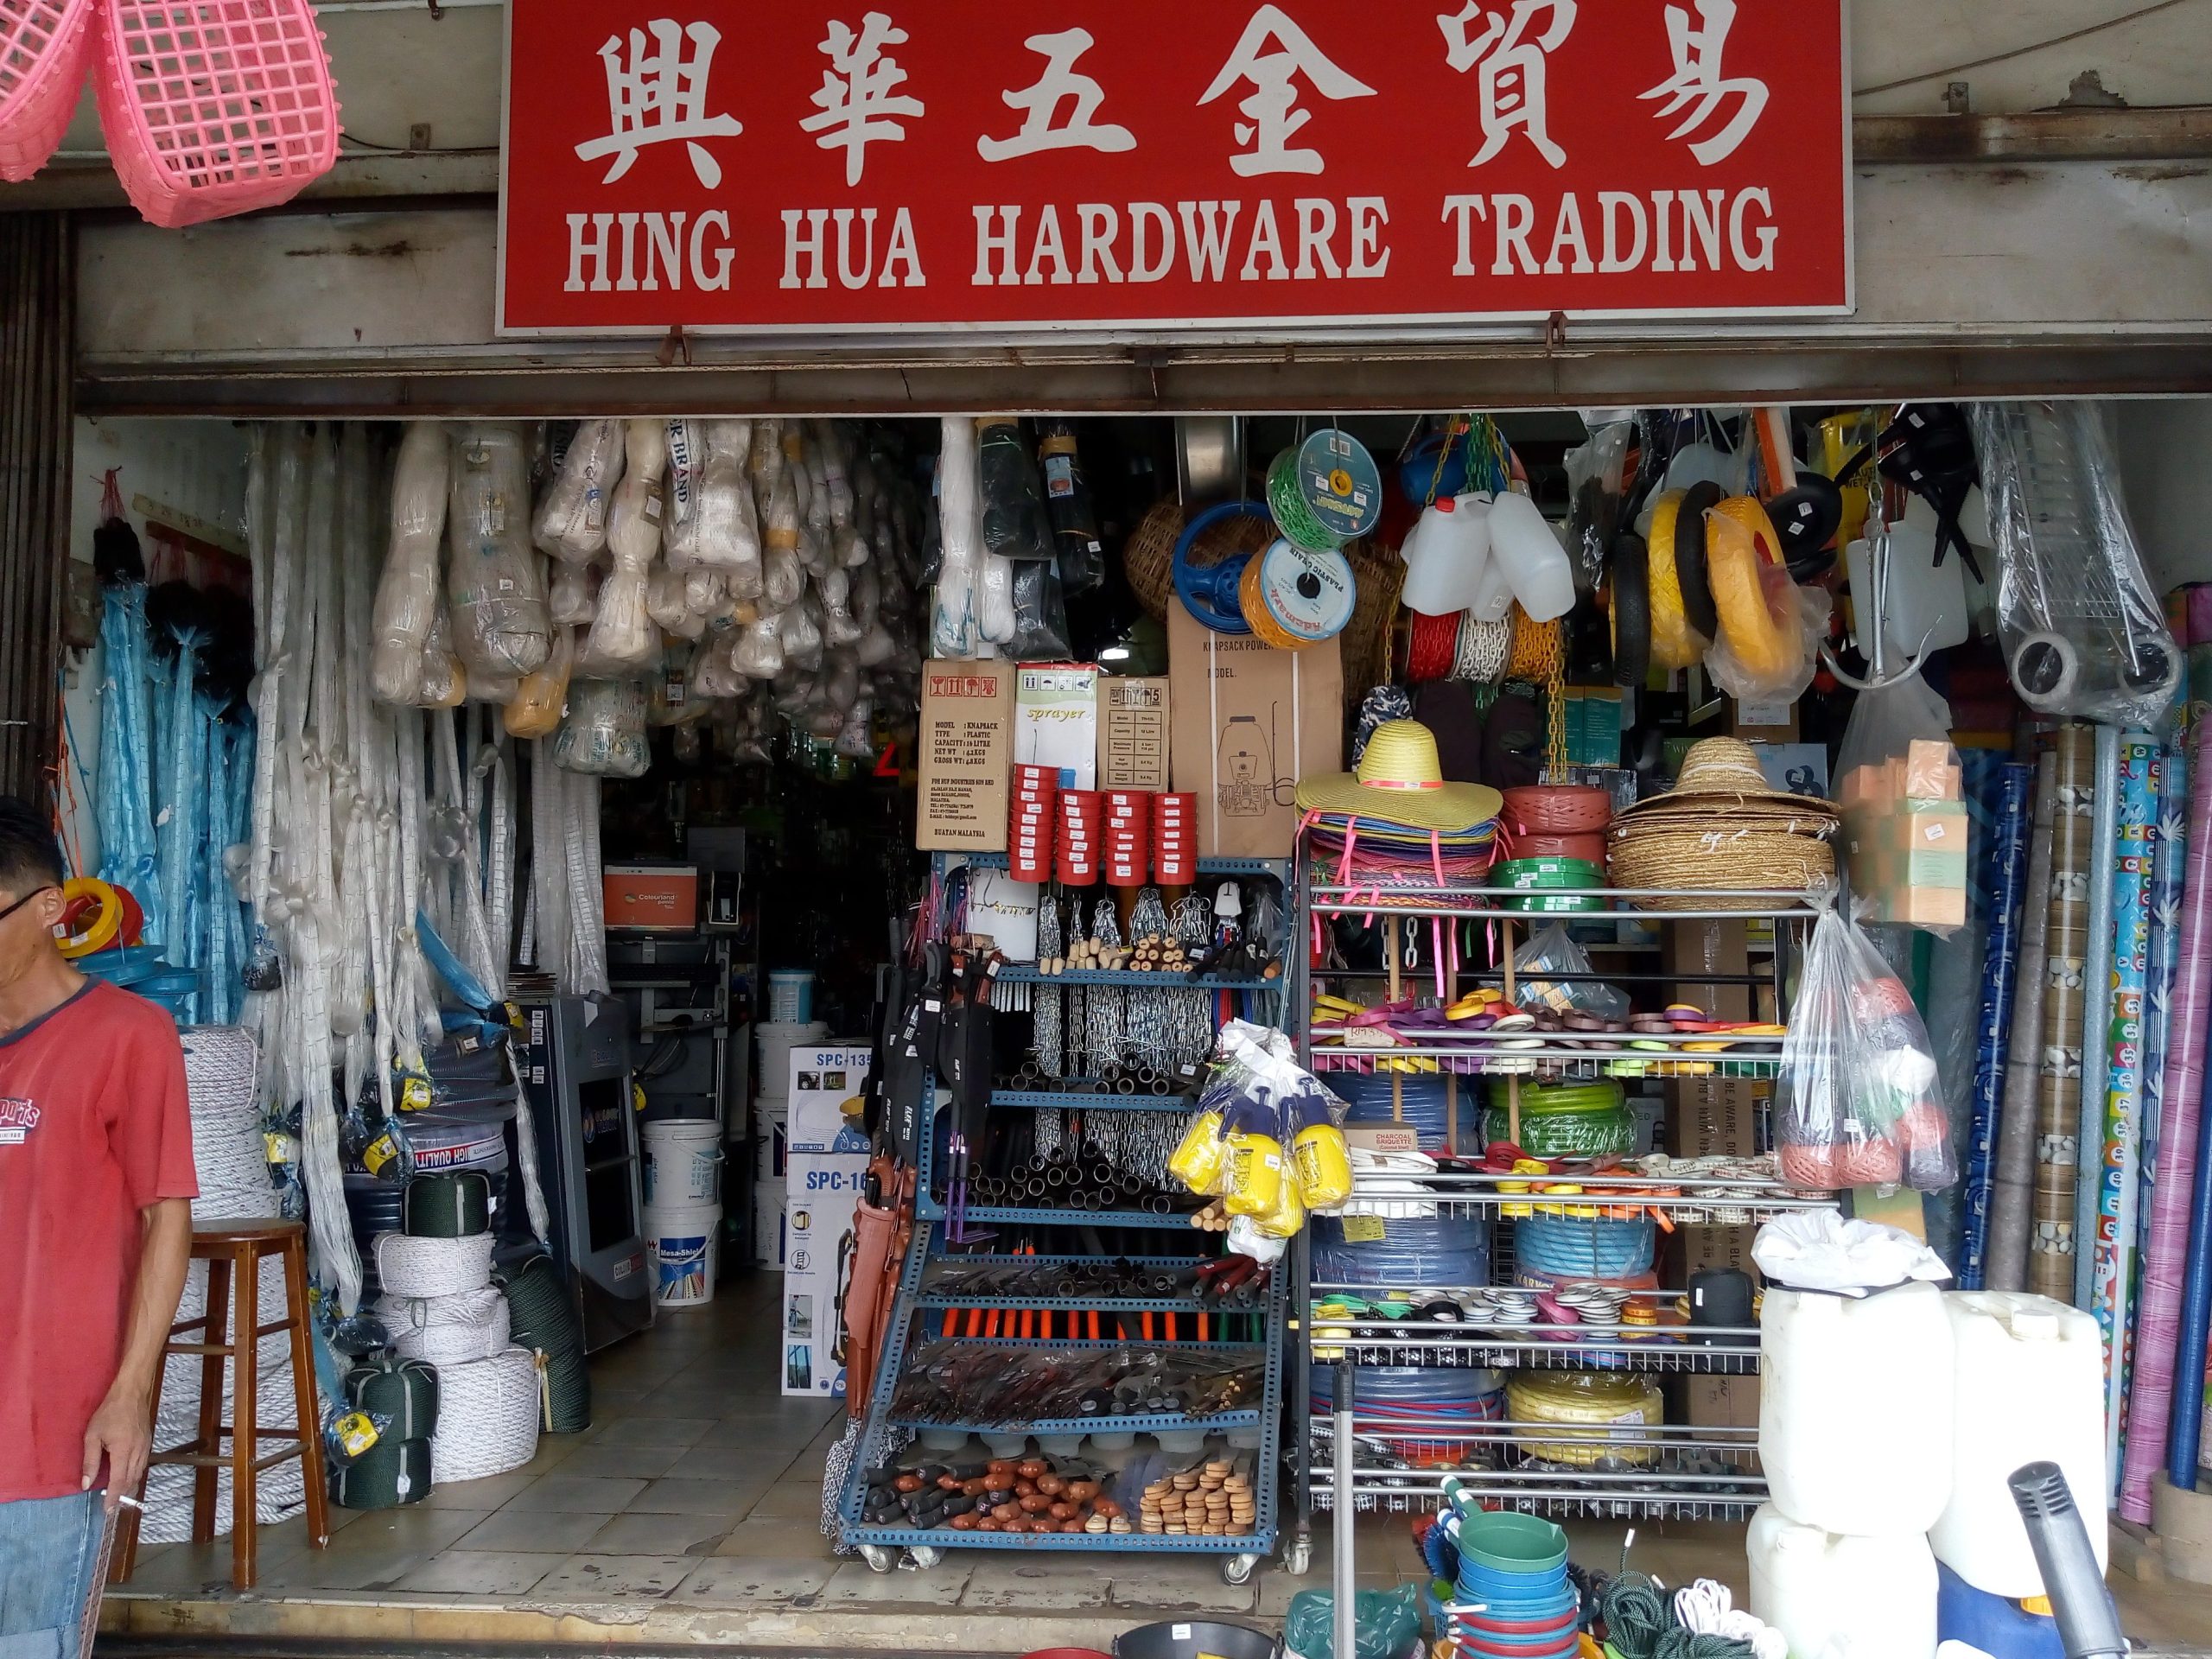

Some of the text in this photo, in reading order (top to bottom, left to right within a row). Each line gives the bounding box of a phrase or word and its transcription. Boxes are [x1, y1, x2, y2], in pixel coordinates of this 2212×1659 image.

[574, 0, 1770, 189] 興華五金貿易
[563, 187, 1779, 292] HING HUA HARDWARE TRADING
[673, 442, 689, 503] BRAND
[1289, 547, 1313, 569] CHAIN
[1313, 566, 1344, 593] PLASTIC
[1203, 641, 1244, 652] KAPSACK
[1027, 708, 1086, 722] sprayer
[2125, 1049, 2133, 1061] 35
[1725, 1082, 1735, 1095] BE
[2120, 1098, 2130, 1109] 37
[1699, 1107, 1709, 1135] WITH
[416, 1149, 451, 1168] QUALITY
